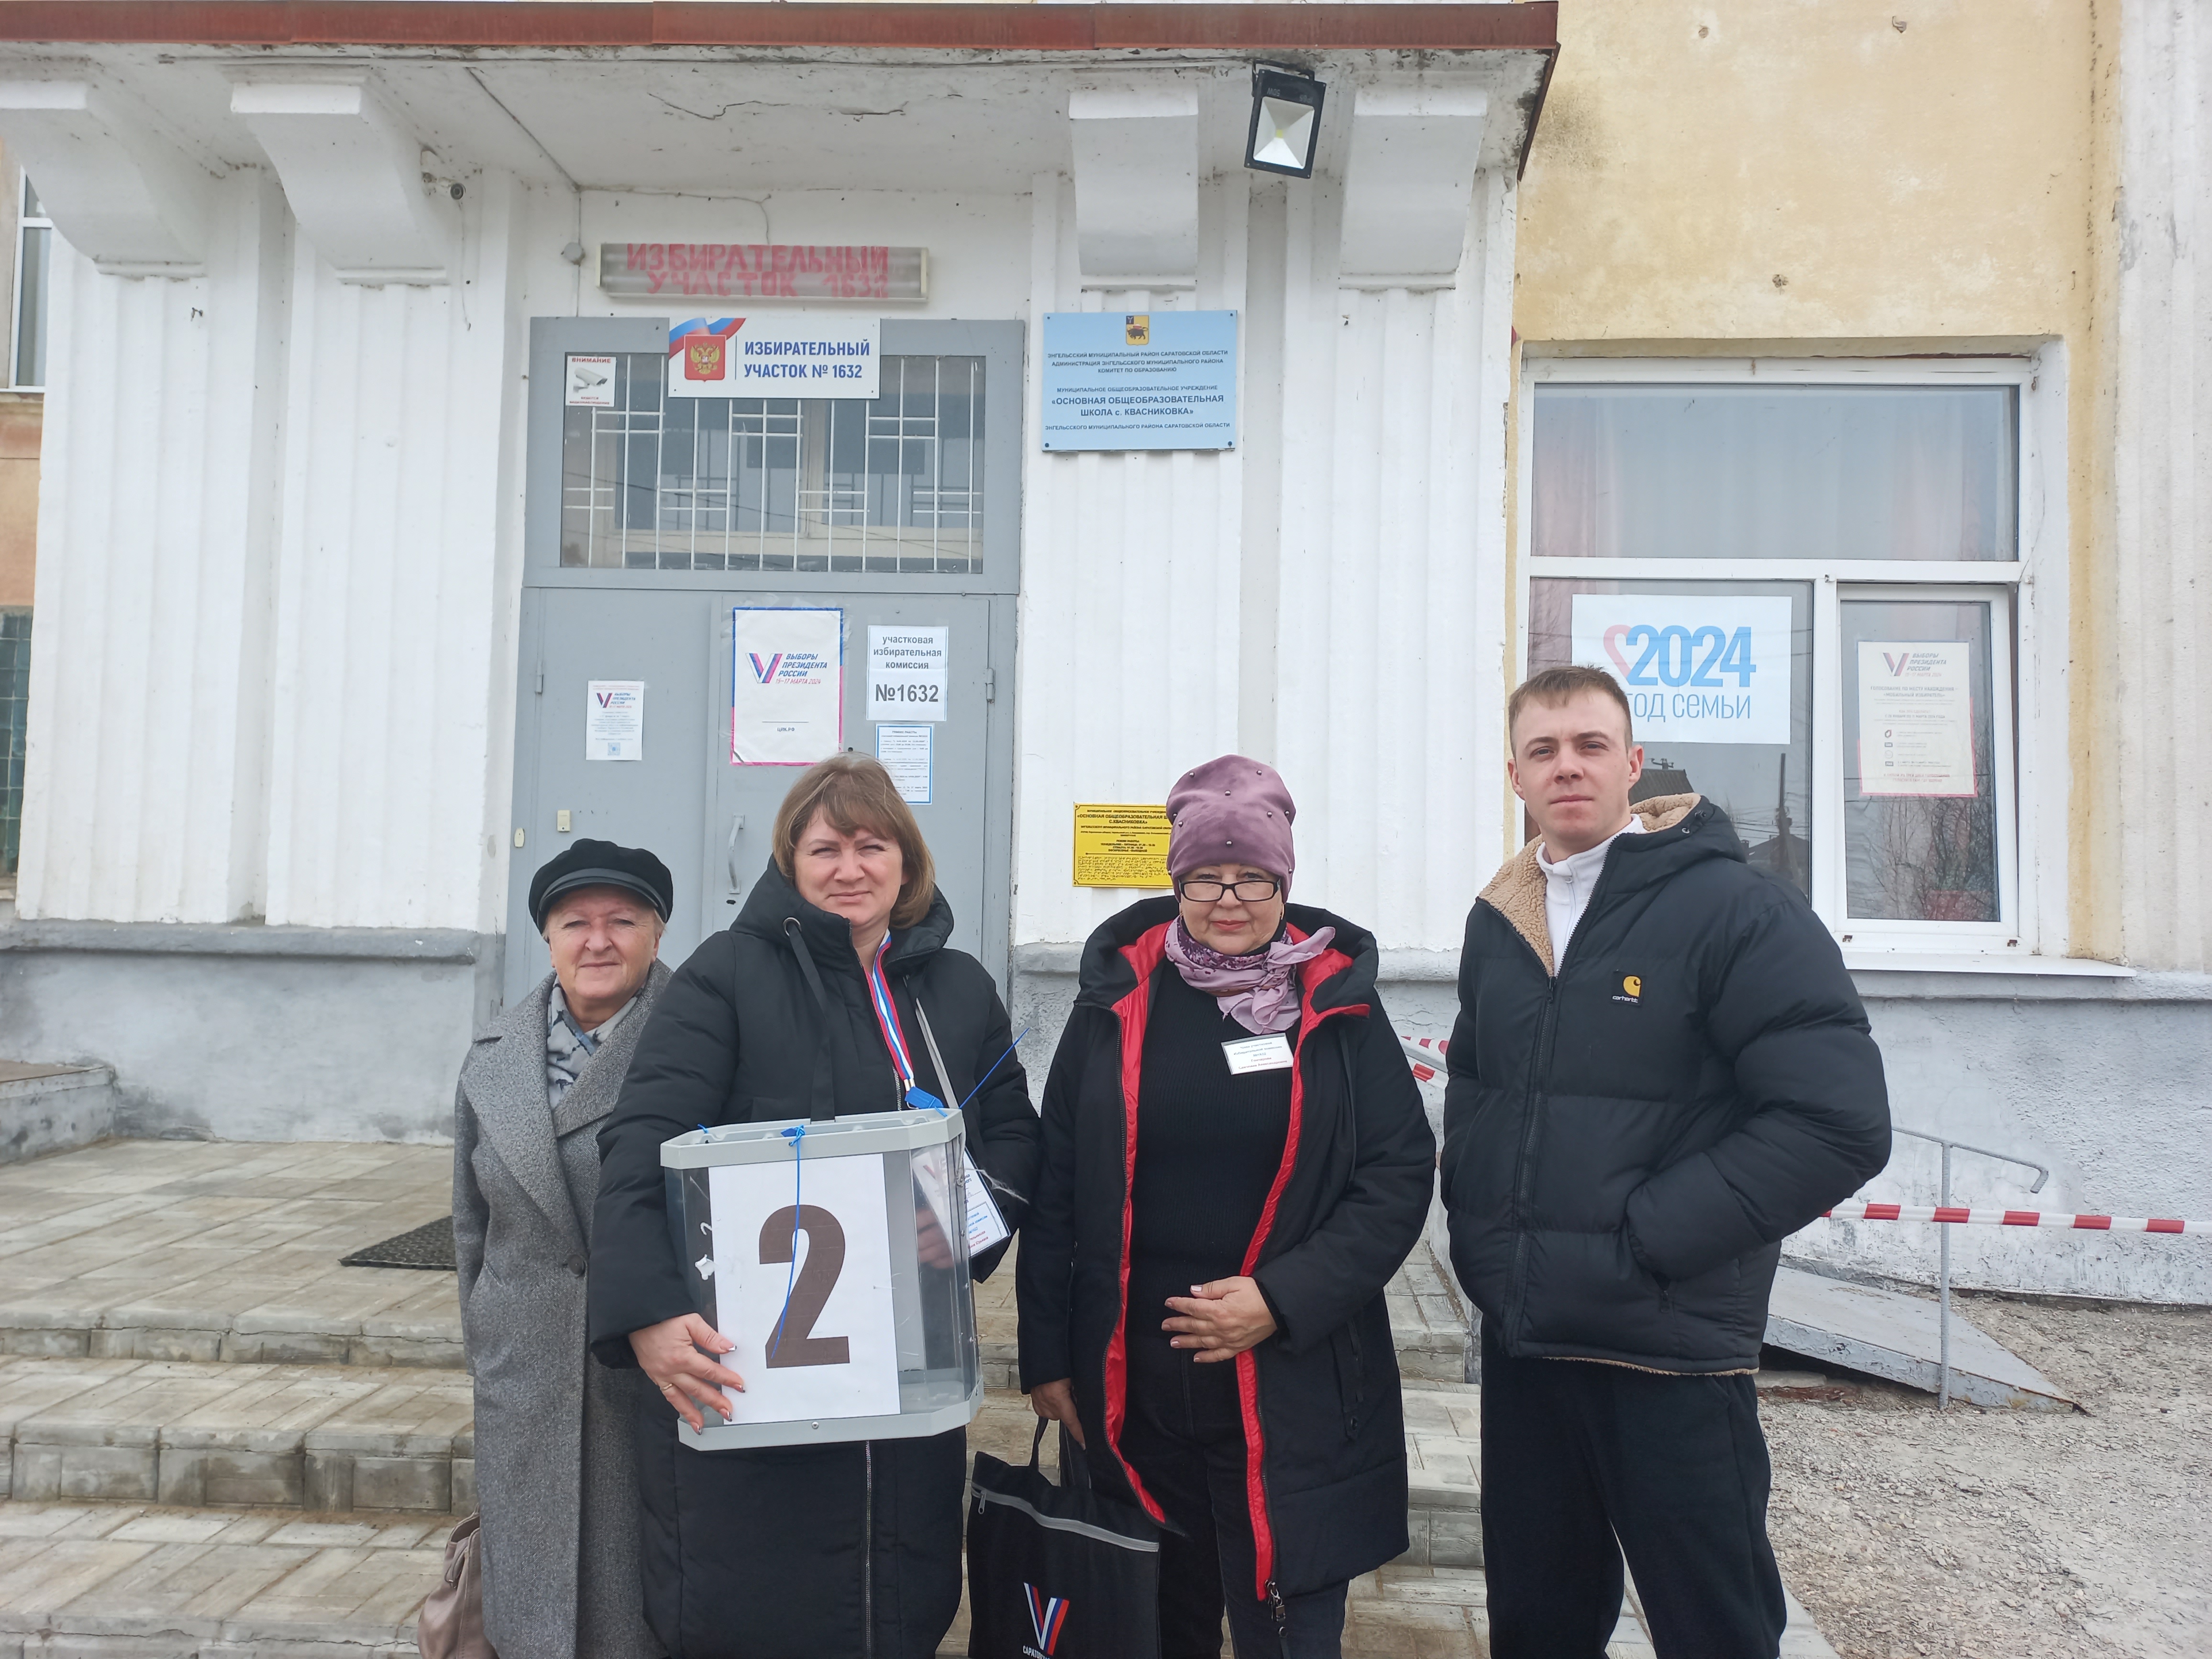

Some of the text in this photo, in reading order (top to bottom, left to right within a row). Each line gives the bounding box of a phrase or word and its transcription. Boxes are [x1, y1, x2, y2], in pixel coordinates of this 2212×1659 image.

[647, 271, 888, 298] УЧАСТОК 1632
[745, 339, 870, 355] ИЗБИРАТЕЛЬНЫЙ
[744, 364, 862, 378] УЧАСТОК № 1632
[1108, 395, 1224, 405] ОБЩЕОБРАЗОВАТЕЛЬНАЯ
[883, 636, 933, 645] участковая
[874, 647, 941, 657] избирательная
[1626, 625, 1756, 687] 2024
[875, 684, 939, 702] №1632
[1626, 693, 1665, 722] ОД
[759, 1204, 850, 1369] 2
